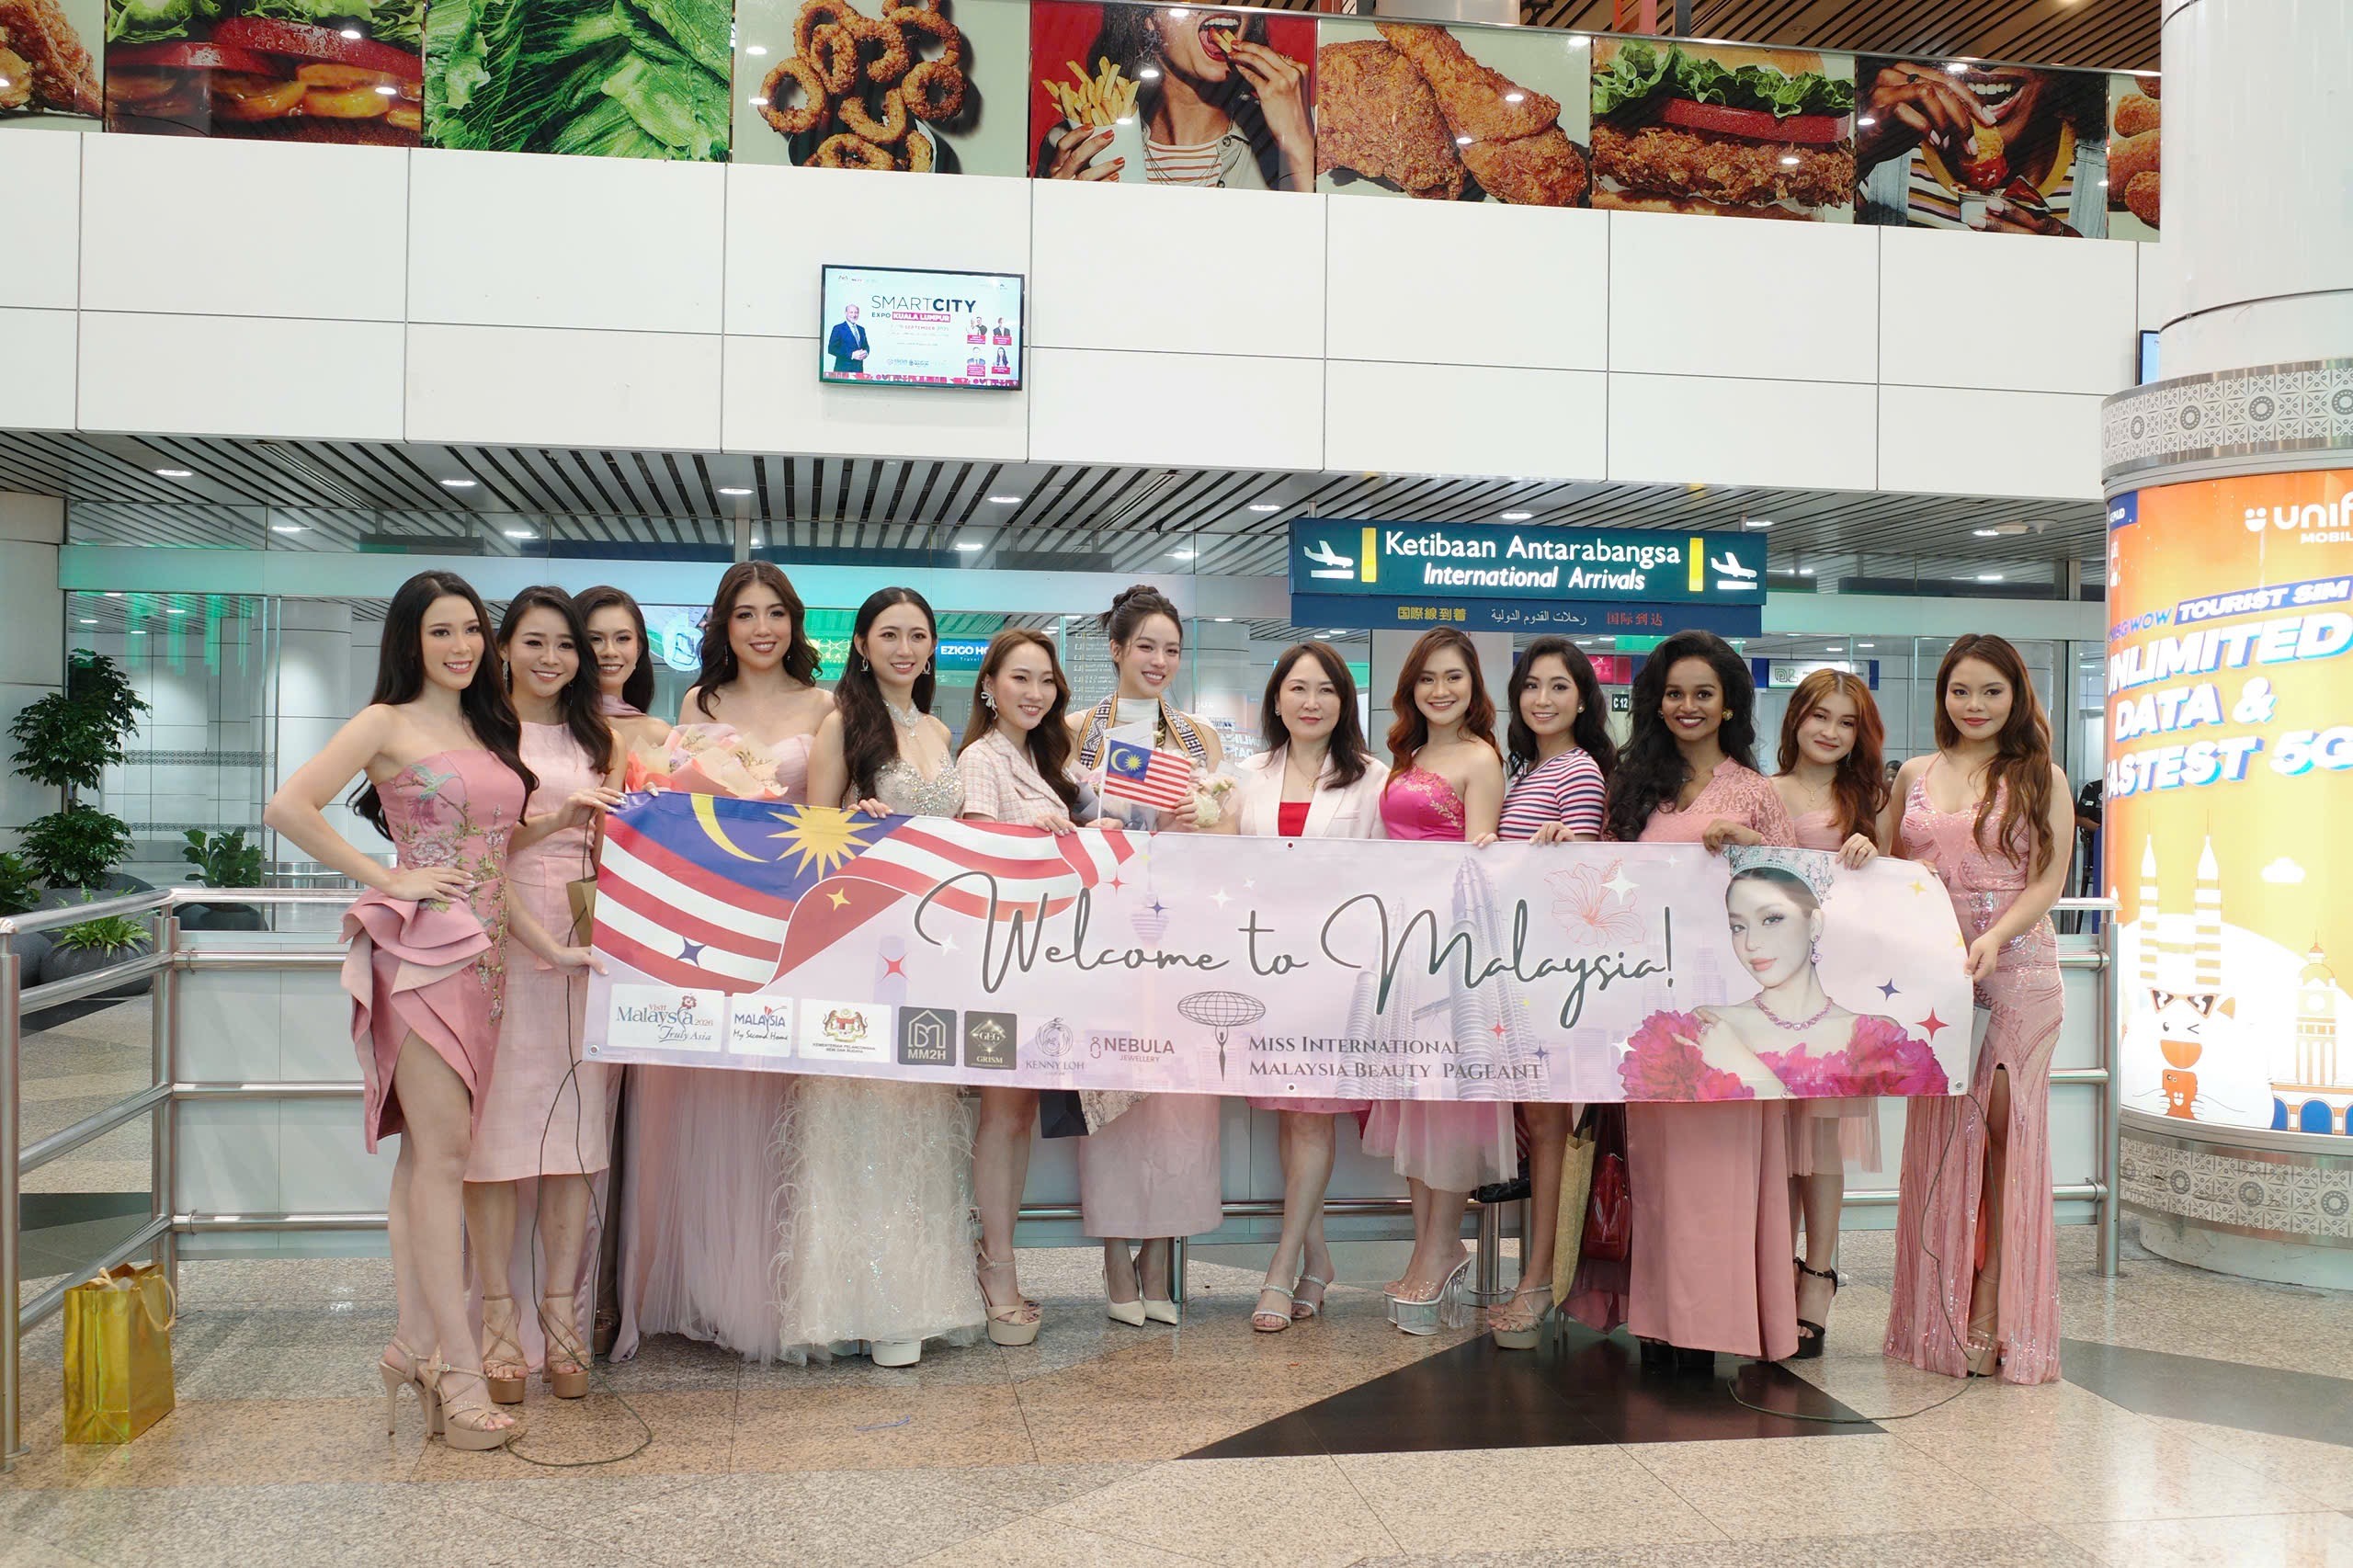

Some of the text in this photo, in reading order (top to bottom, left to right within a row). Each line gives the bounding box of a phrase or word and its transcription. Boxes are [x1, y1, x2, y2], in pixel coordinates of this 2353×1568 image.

[871, 295, 976, 312] SMARTCITY
[1385, 530, 1681, 570] Ketibaan Antarabangsa
[1424, 562, 1645, 590] International Arrivals
[2178, 588, 2289, 621] TOURIST
[2291, 579, 2351, 604] SIM
[1397, 607, 1468, 621] 国際線到着
[1491, 608, 1587, 625] رحلات القدوم الدولية
[1606, 611, 1664, 626] 国际到达
[940, 645, 974, 655] EZIGO
[1613, 698, 1629, 709] C 12
[2115, 676, 2278, 743] DATA &
[2108, 735, 2265, 801] ASTEST
[914, 871, 1675, 1028] Welcome to Malaysia!
[616, 1006, 693, 1027] Malaysia
[734, 1012, 786, 1028] MALAYSIA
[658, 1024, 711, 1042] Truly Asia
[733, 1029, 744, 1040] My
[1104, 1037, 1176, 1055] NEBULA
[1248, 1036, 1464, 1055] MISS INTERNATIONAL
[907, 1049, 946, 1060] MM2H
[976, 1055, 1003, 1063] GRISM
[1026, 1060, 1085, 1070] KENNY LOH
[1249, 1062, 1542, 1080] MALAYSIA BEAUTY PAGEANT
